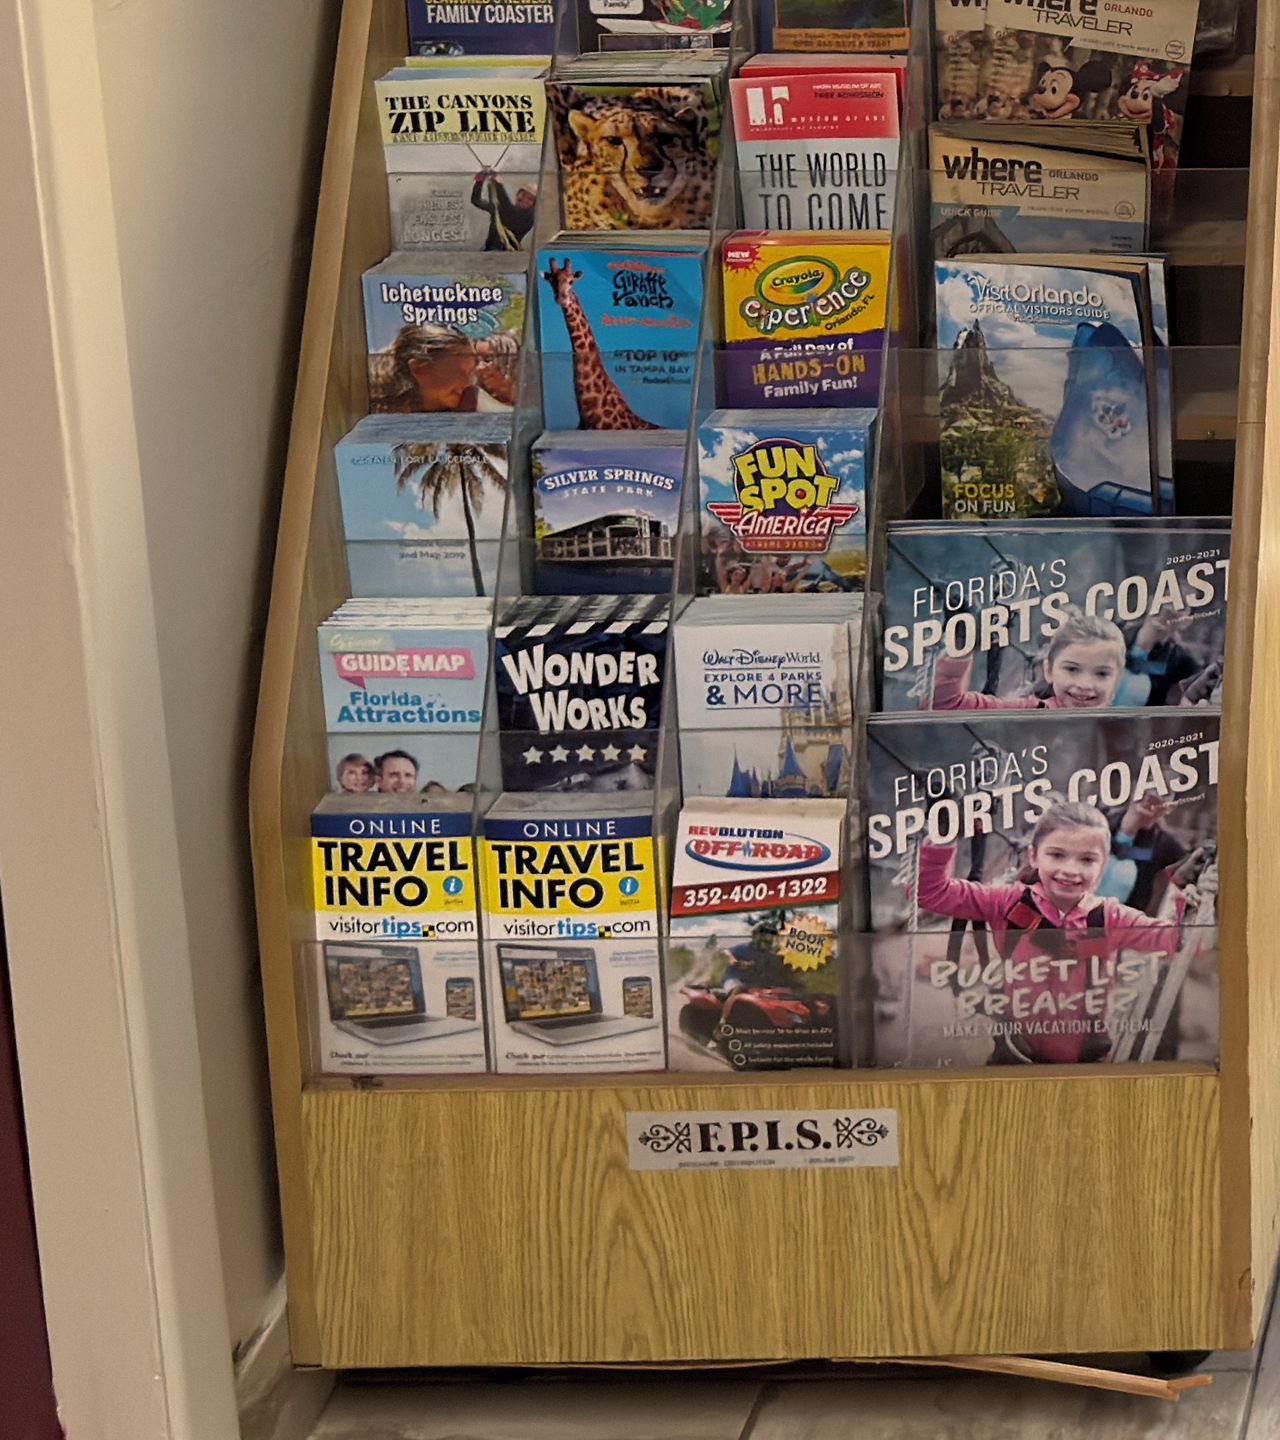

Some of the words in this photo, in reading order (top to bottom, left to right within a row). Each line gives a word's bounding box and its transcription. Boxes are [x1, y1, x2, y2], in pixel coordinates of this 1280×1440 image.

[427, 5, 481, 24] FAMILY
[485, 5, 554, 24] COASTER
[1103, 2, 1153, 17] ORLANDO
[1033, 9, 1132, 35] TRAVELER
[385, 96, 430, 110] THE
[438, 94, 532, 108] CANYONS
[389, 111, 445, 133] ZIP
[458, 111, 535, 132] LINE
[756, 154, 797, 188] THE
[807, 153, 886, 187] WORLD
[942, 147, 1042, 183] where
[1049, 169, 1099, 181] ORLANDO
[977, 182, 1080, 200] TRAVELER
[759, 194, 791, 230] TO
[808, 193, 889, 230] COME
[772, 269, 820, 286] Crayola
[381, 283, 503, 302] Ichetucknee
[968, 275, 1011, 301] Visit
[1011, 283, 1103, 307] Orlando
[403, 304, 478, 325] Springs
[825, 303, 866, 330] Orlando,
[863, 294, 874, 306] FL
[969, 303, 1018, 314] OFFICIAL
[1022, 305, 1073, 316] VISITORS
[1076, 308, 1110, 319] GUIDE
[760, 349, 771, 360] A
[774, 344, 801, 359] Full
[805, 343, 834, 355] Day
[838, 339, 853, 350] of
[629, 365, 664, 373] TAMPA
[753, 355, 865, 385] HANDS-ON
[764, 381, 820, 398] Family
[822, 377, 857, 391] Fun!
[735, 447, 816, 486] FUN
[544, 469, 598, 489] SILVER
[604, 469, 674, 489] SPRINGS
[564, 486, 606, 498] STATE
[616, 486, 654, 497] PARK
[740, 476, 837, 515] SPOT
[952, 484, 1015, 498] FOCUS
[955, 501, 978, 512] ON
[983, 500, 1016, 512] FUN
[735, 511, 832, 536] AMERICA
[1166, 549, 1221, 565] 2020-2021
[913, 559, 1067, 618] FLORIDA'S
[884, 591, 1069, 672] SPORTS
[341, 654, 410, 671] GUIDE
[413, 654, 465, 671] MAP
[501, 643, 660, 695] WONDER
[704, 673, 762, 682] EXPLORE
[781, 672, 821, 681] PARKS
[351, 691, 421, 706] Florida
[706, 685, 726, 705] &
[734, 683, 821, 704] MORE
[337, 704, 481, 723] Attractions
[529, 689, 646, 735] WORKS
[1149, 732, 1204, 751] 2020-2021
[894, 745, 1049, 806] FLORIDA'S
[868, 778, 1052, 860] SPORTS
[1068, 741, 1219, 808] COAST
[350, 819, 441, 834] ONLINE
[524, 821, 616, 838] ONLINE
[688, 826, 783, 838] REVOLUTION
[318, 841, 468, 871] TRAVEL
[492, 842, 644, 874] TRAVEL
[694, 840, 742, 856] OFF
[751, 843, 822, 859] ROAD
[325, 875, 428, 906] INFO
[500, 878, 603, 909] INFO
[683, 878, 827, 908] 352-400-1322
[329, 915, 473, 938] visitortips.com
[504, 918, 650, 939] visitortips.com
[785, 939, 822, 957] NOW!
[789, 928, 826, 947] BOOK
[929, 955, 1078, 989] BUCKET
[1091, 950, 1167, 986] LIST
[958, 986, 1138, 1018] BREAKER
[985, 1022, 1022, 1037] YOUR
[1026, 1020, 1090, 1034] VACATION
[697, 1119, 832, 1153] F.P.I.S.
